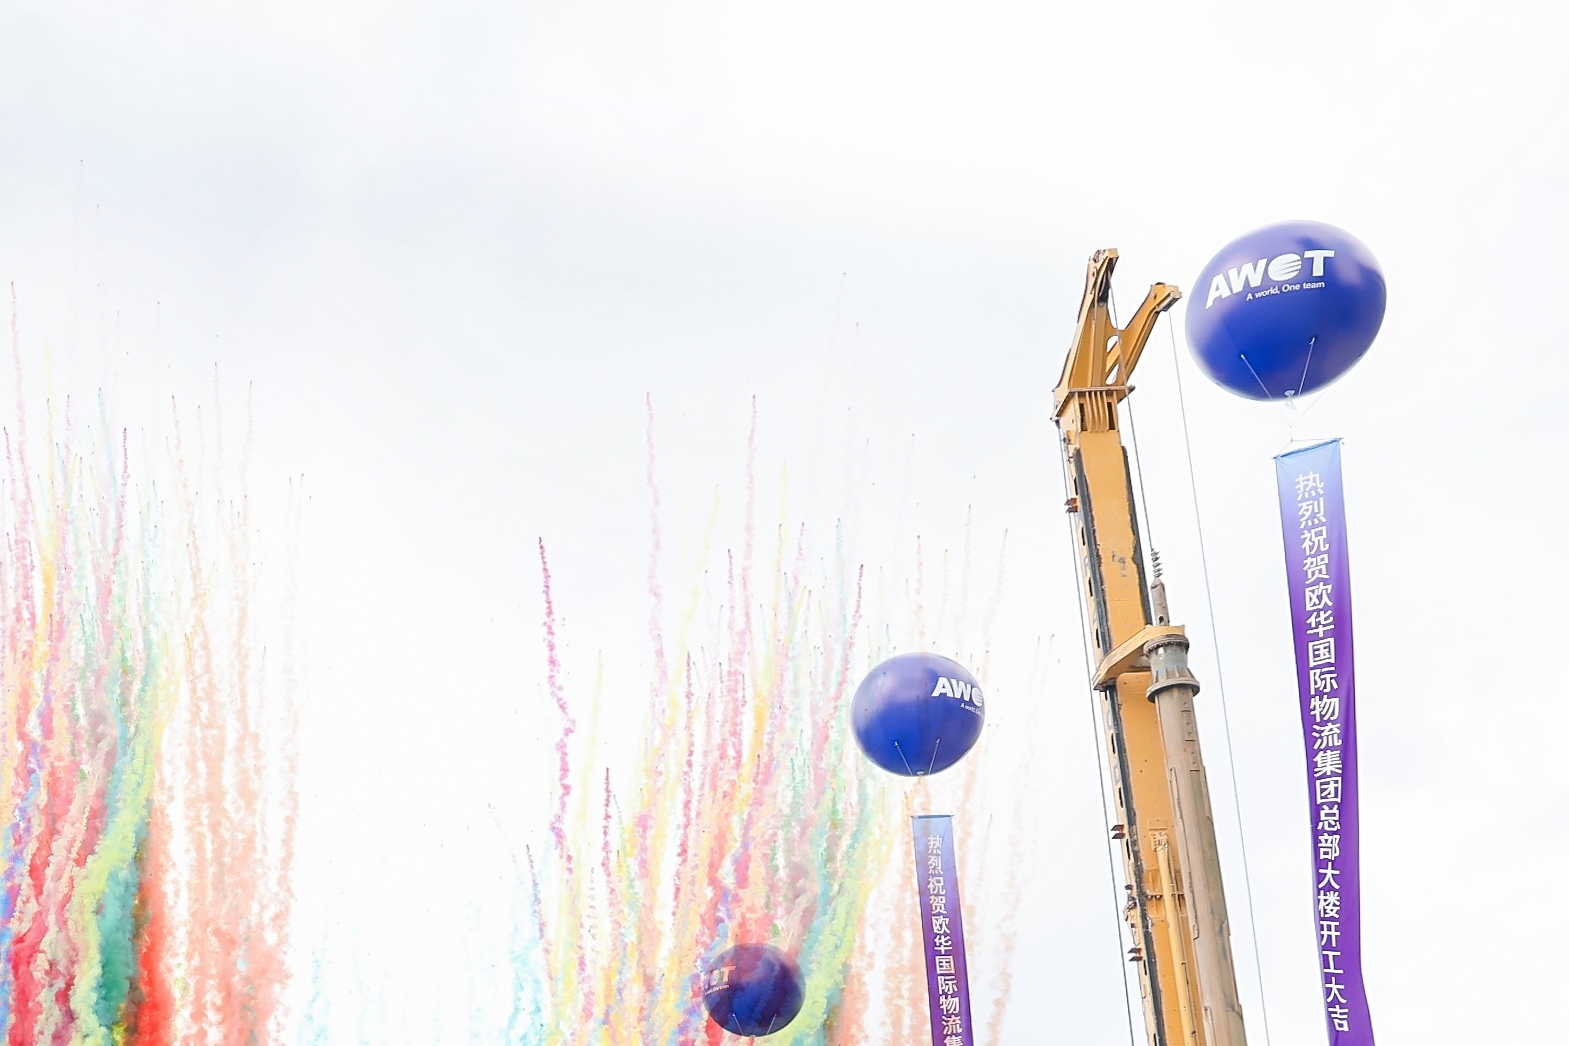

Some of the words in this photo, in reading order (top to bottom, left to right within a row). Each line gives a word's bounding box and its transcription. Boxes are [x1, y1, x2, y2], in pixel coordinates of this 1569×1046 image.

[1205, 250, 1335, 309] AWOT
[1246, 293, 1254, 301] A
[1255, 287, 1280, 299] world,
[1282, 283, 1300, 293] One
[1303, 281, 1325, 289] team
[1295, 471, 1350, 1033] 热烈祝贺欧华国际物流集团总部大楼开工大吉
